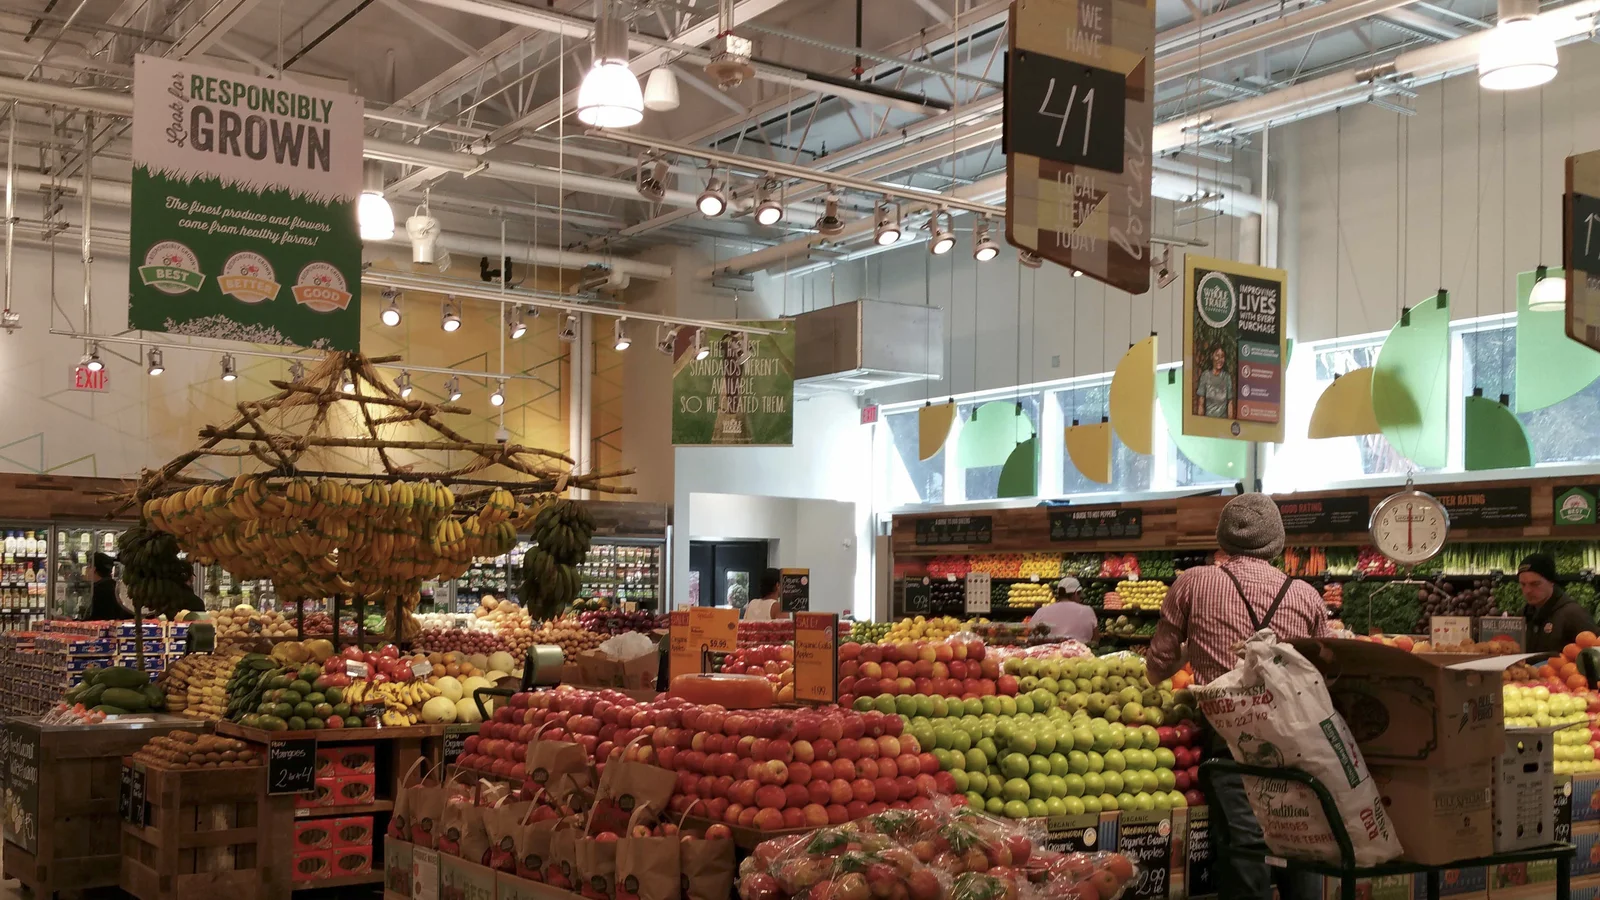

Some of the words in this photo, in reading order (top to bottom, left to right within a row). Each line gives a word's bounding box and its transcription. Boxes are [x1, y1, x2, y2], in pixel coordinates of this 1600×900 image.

[1081, 4, 1103, 31] WE
[1066, 27, 1103, 59] HAVE
[168, 72, 189, 102] for
[190, 74, 333, 124] RESPONSIBLY
[166, 101, 187, 148] Look
[1038, 77, 1096, 156] 41
[190, 105, 331, 172] GROWN
[1057, 170, 1099, 201] LOCAL
[165, 196, 188, 211] The
[188, 200, 222, 217] finest
[221, 206, 267, 226] produce
[269, 212, 291, 226] and
[290, 216, 331, 233] flowers
[1058, 200, 1097, 228] ITEMS
[178, 217, 209, 232] come
[208, 221, 238, 237] from
[239, 226, 280, 245] healthy
[280, 231, 319, 247] farms!
[1055, 224, 1097, 254] TODAY
[156, 268, 189, 282] BEST
[226, 278, 273, 294] BETTER
[303, 288, 340, 302] GOOD
[1239, 284, 1277, 298] IMPROVING
[1239, 294, 1277, 315] LIVES
[1238, 320, 1276, 335] PURCHASE
[1240, 311, 1256, 321] WITH
[1257, 313, 1276, 325] EVERY
[709, 340, 724, 358] THE
[76, 367, 105, 389] EXIT
[689, 359, 742, 376] STANDARDS
[744, 358, 779, 376] WEREN'T
[681, 396, 702, 413] SO
[706, 396, 717, 413] WE
[721, 396, 759, 414] CREATED
[762, 396, 787, 413] THEM.
[1299, 502, 1323, 513] RATING
[1458, 494, 1485, 506] RATING
[271, 749, 306, 760] Mangoes
[275, 768, 289, 788] 2
[1360, 808, 1379, 841] RED
[1374, 796, 1389, 841] WASHED
